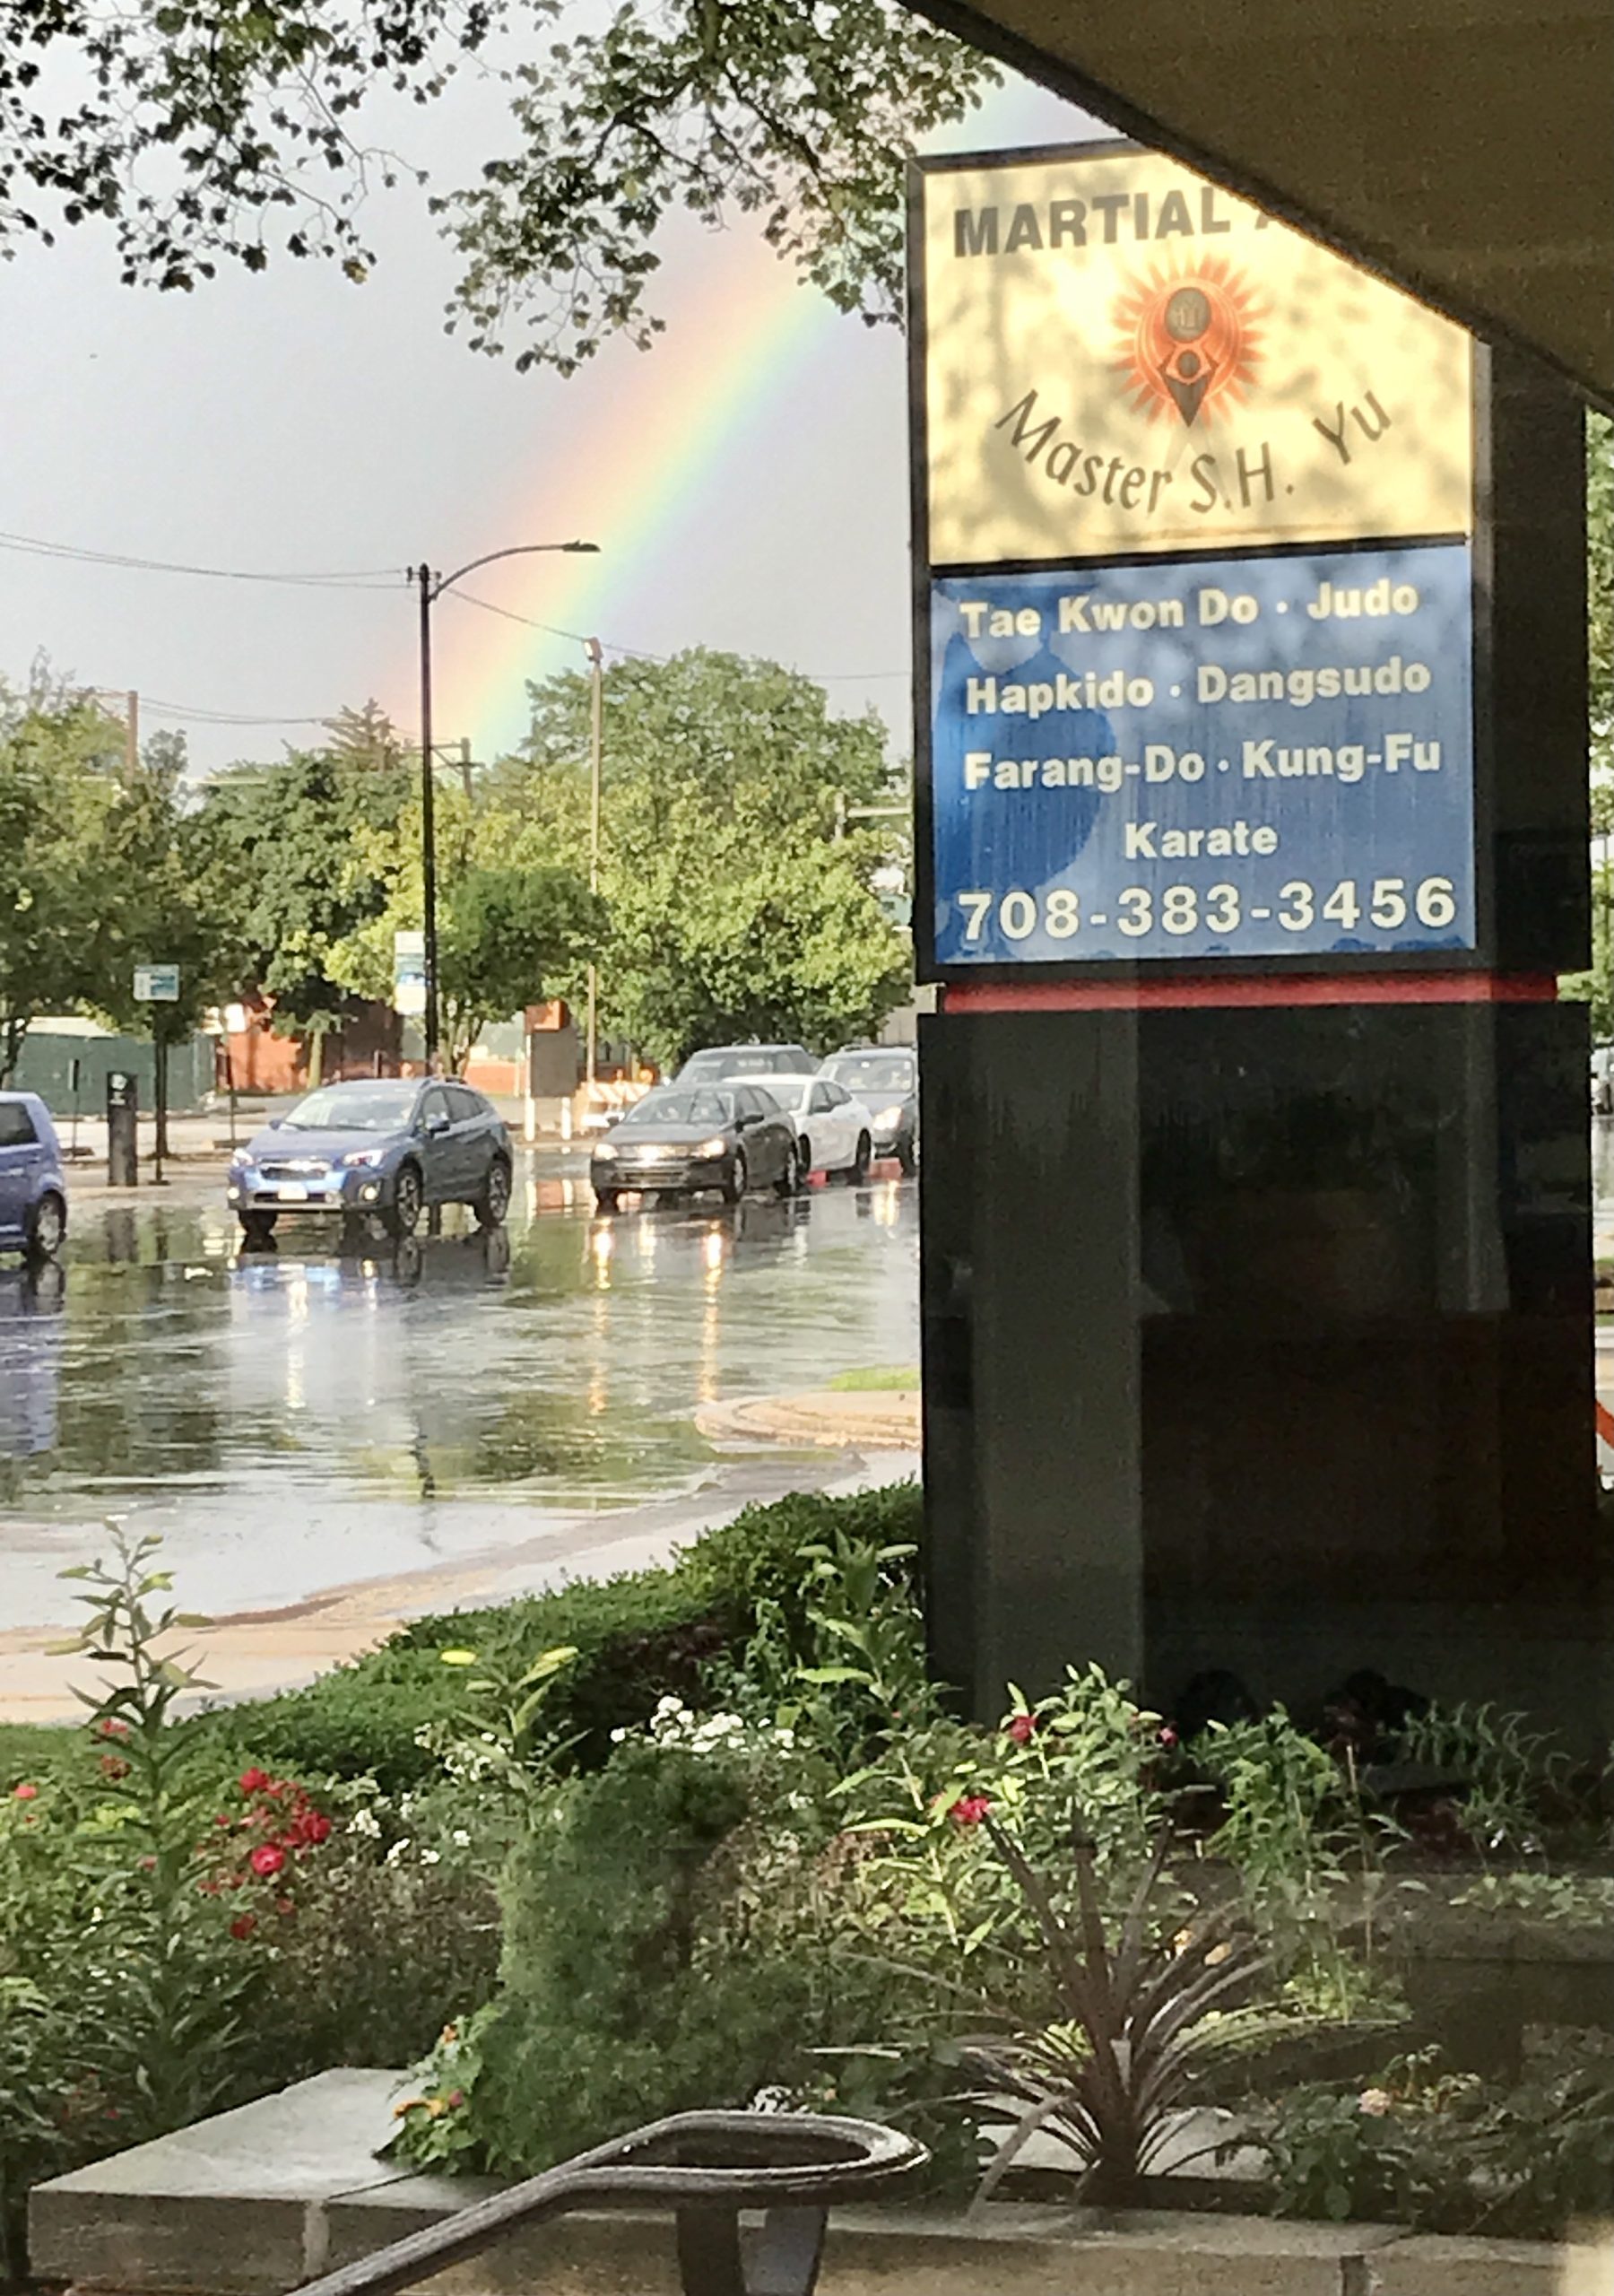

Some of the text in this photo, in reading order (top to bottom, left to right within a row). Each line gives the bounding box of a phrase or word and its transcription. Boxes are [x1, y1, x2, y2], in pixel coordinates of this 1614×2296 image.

[954, 187, 1231, 257] MARTIAL
[995, 389, 1392, 514] Master S.H. Yu
[959, 578, 1419, 639] Tae Kwon Do Judo
[966, 657, 1431, 718] Hapkido Dangsudo
[964, 733, 1440, 793] Farang-Do Kung-Fu
[1124, 821, 1278, 859] Karate
[958, 877, 1456, 942] 708-383-3456
